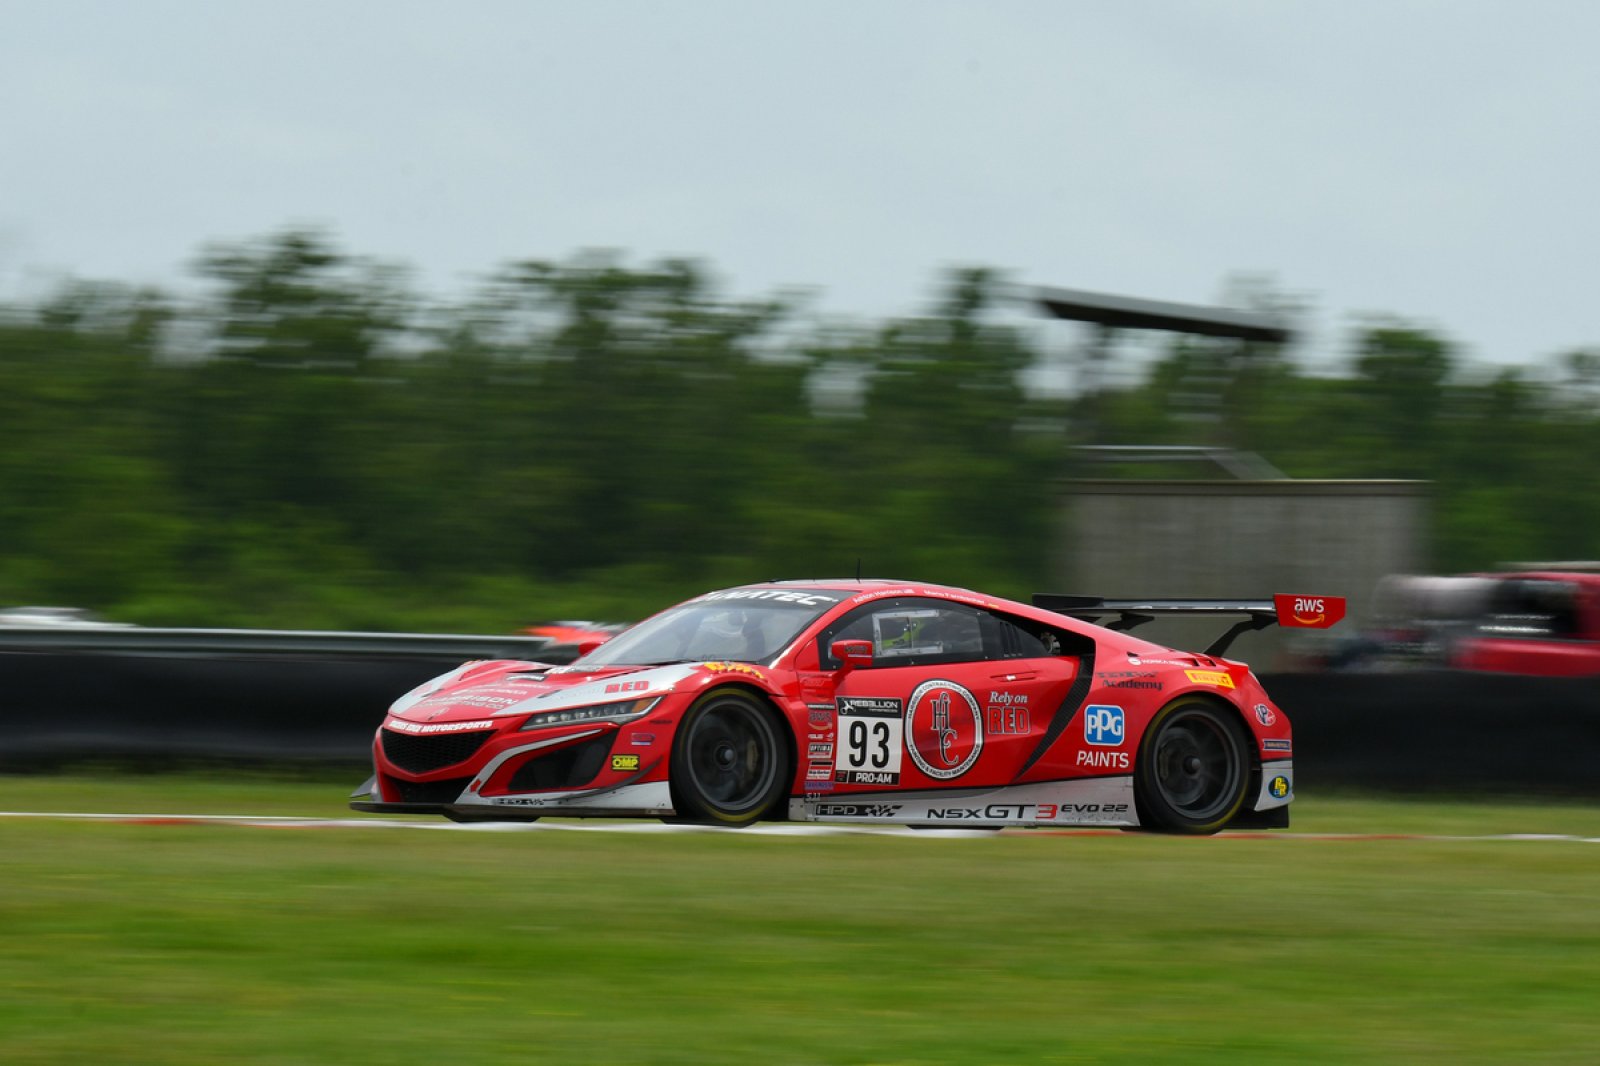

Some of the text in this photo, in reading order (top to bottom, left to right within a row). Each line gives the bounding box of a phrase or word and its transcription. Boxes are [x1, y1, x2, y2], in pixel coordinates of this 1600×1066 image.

[1294, 597, 1325, 614] aws
[604, 680, 650, 694] RED
[1101, 679, 1164, 691] Academy
[849, 699, 898, 709] REBELLION
[988, 691, 1028, 706] Rely on
[420, 720, 494, 733] MOTORSPORTS
[988, 706, 1031, 735] RED
[1087, 709, 1122, 741] PPG
[848, 720, 890, 769] 93
[612, 757, 639, 768] OMP
[1076, 750, 1130, 768] PAINTS
[855, 772, 893, 784] PRO-AM
[817, 805, 858, 816] HPD
[927, 808, 981, 819] NSX
[1060, 804, 1099, 813] EVO
[1102, 804, 1128, 813] 22
